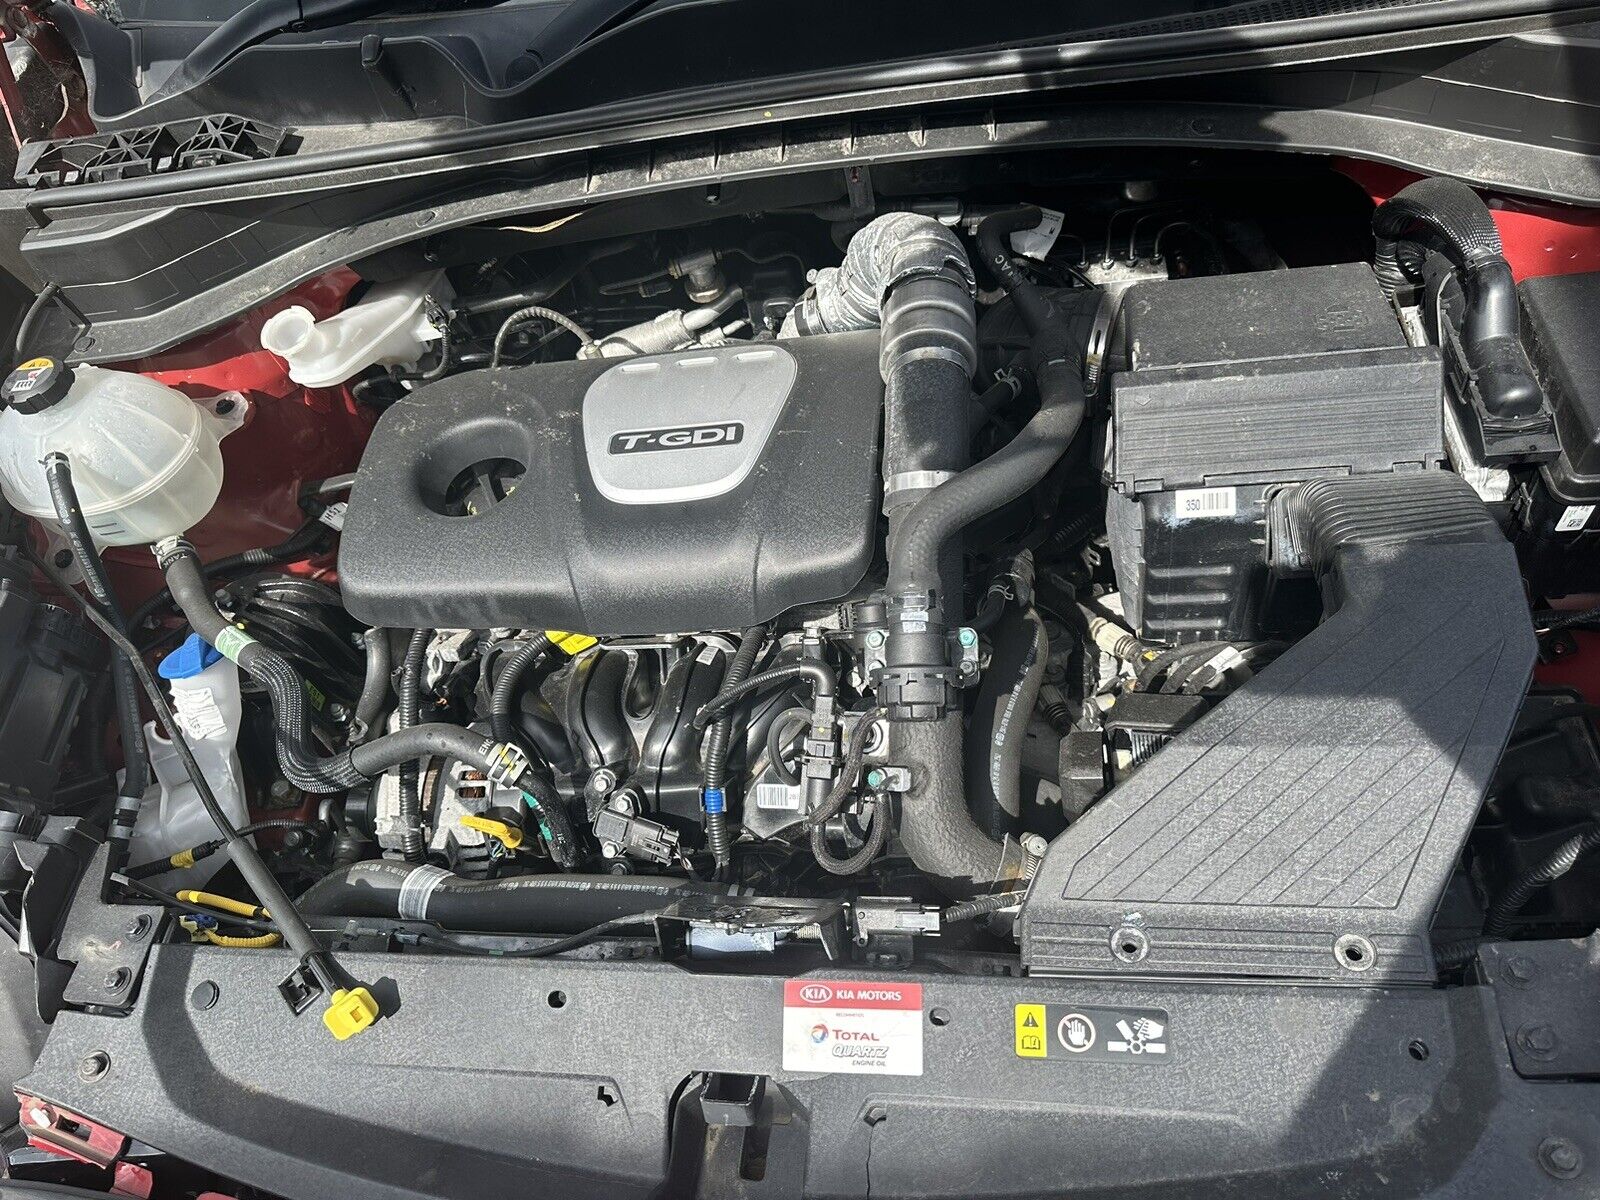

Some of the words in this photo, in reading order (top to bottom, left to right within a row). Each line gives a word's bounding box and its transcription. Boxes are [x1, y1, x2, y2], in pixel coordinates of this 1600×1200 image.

[618, 425, 737, 450] T-GDI
[1185, 499, 1201, 512] 350
[162, 553, 188, 568] TANK
[836, 990, 855, 1000] KIA
[856, 991, 902, 1001] MOTORS
[832, 1044, 888, 1058] QUARTZ
